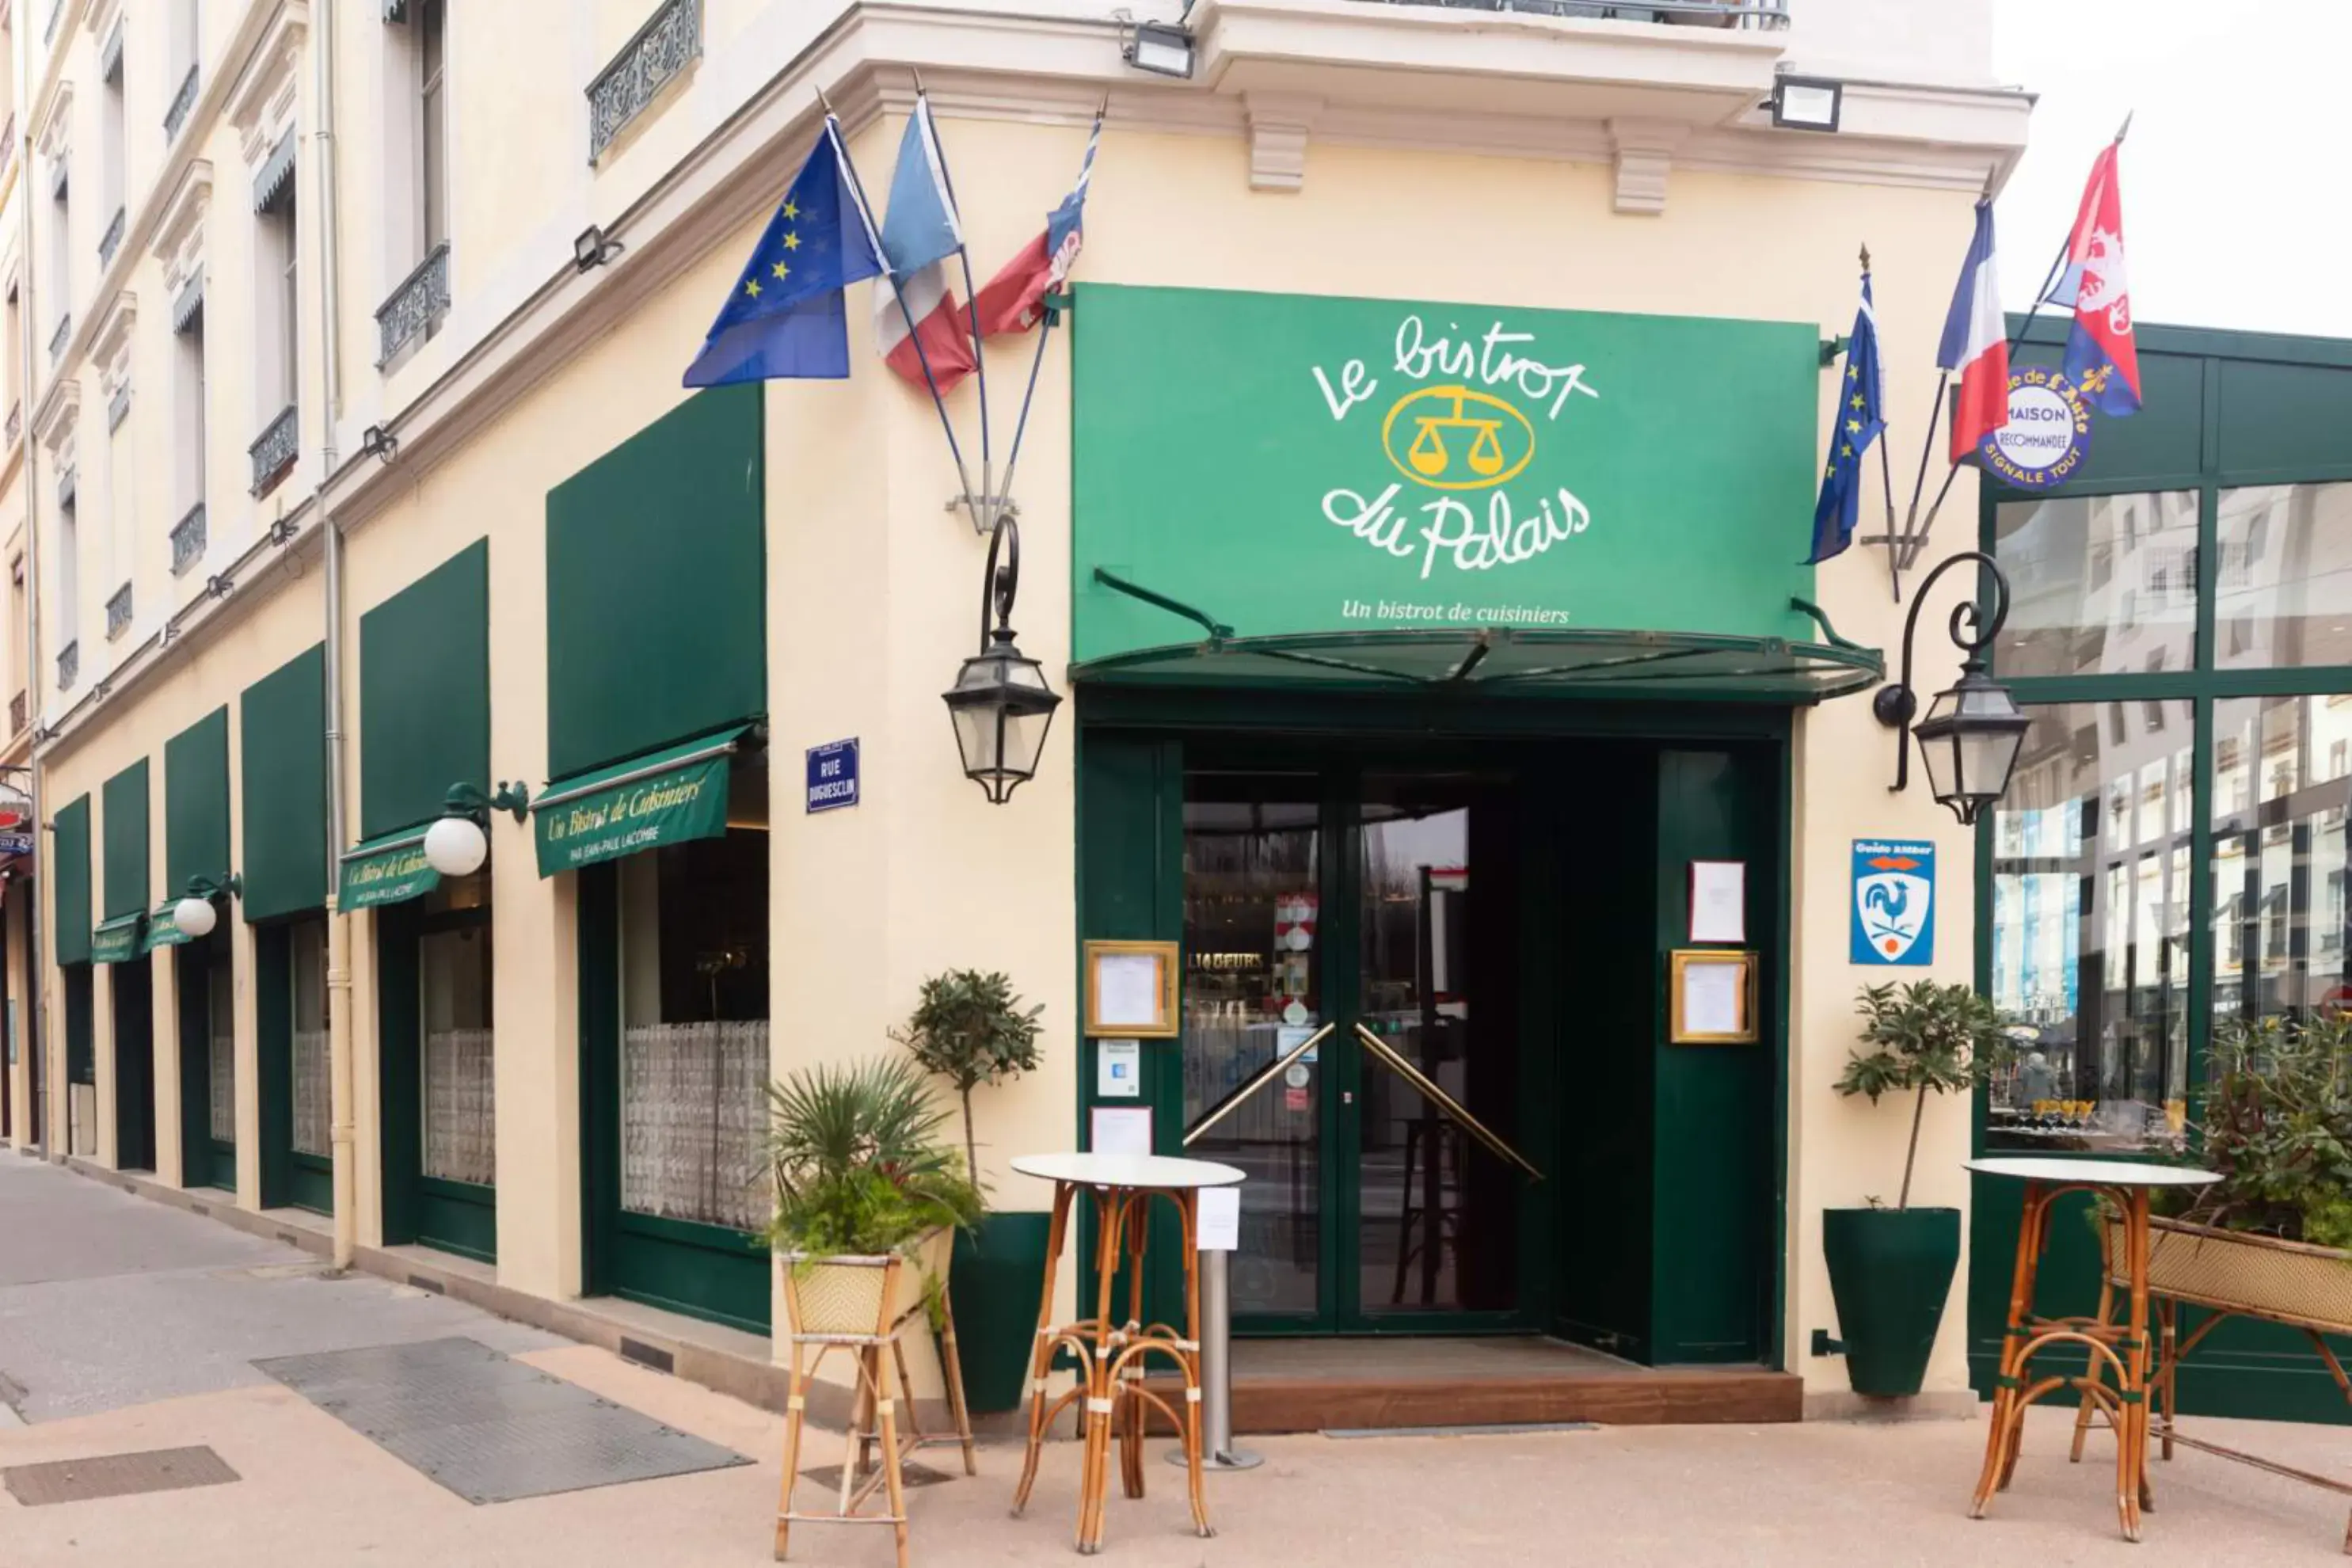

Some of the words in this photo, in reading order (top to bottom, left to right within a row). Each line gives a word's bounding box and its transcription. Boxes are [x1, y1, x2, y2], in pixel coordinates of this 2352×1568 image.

[1312, 358, 1379, 421] Le
[1393, 314, 1600, 421] bistrot
[2023, 368, 2046, 385] de
[1985, 443, 2045, 483] SIGNALE
[2049, 446, 2081, 478] TOUT
[1321, 482, 1416, 557] du
[1419, 486, 1591, 580] Palais
[1342, 599, 1372, 619] Un
[1376, 599, 1444, 620] bistrot
[1447, 602, 1472, 622] de
[1475, 605, 1570, 625] cuisiniers
[820, 758, 841, 778] RUE
[610, 793, 627, 824] de
